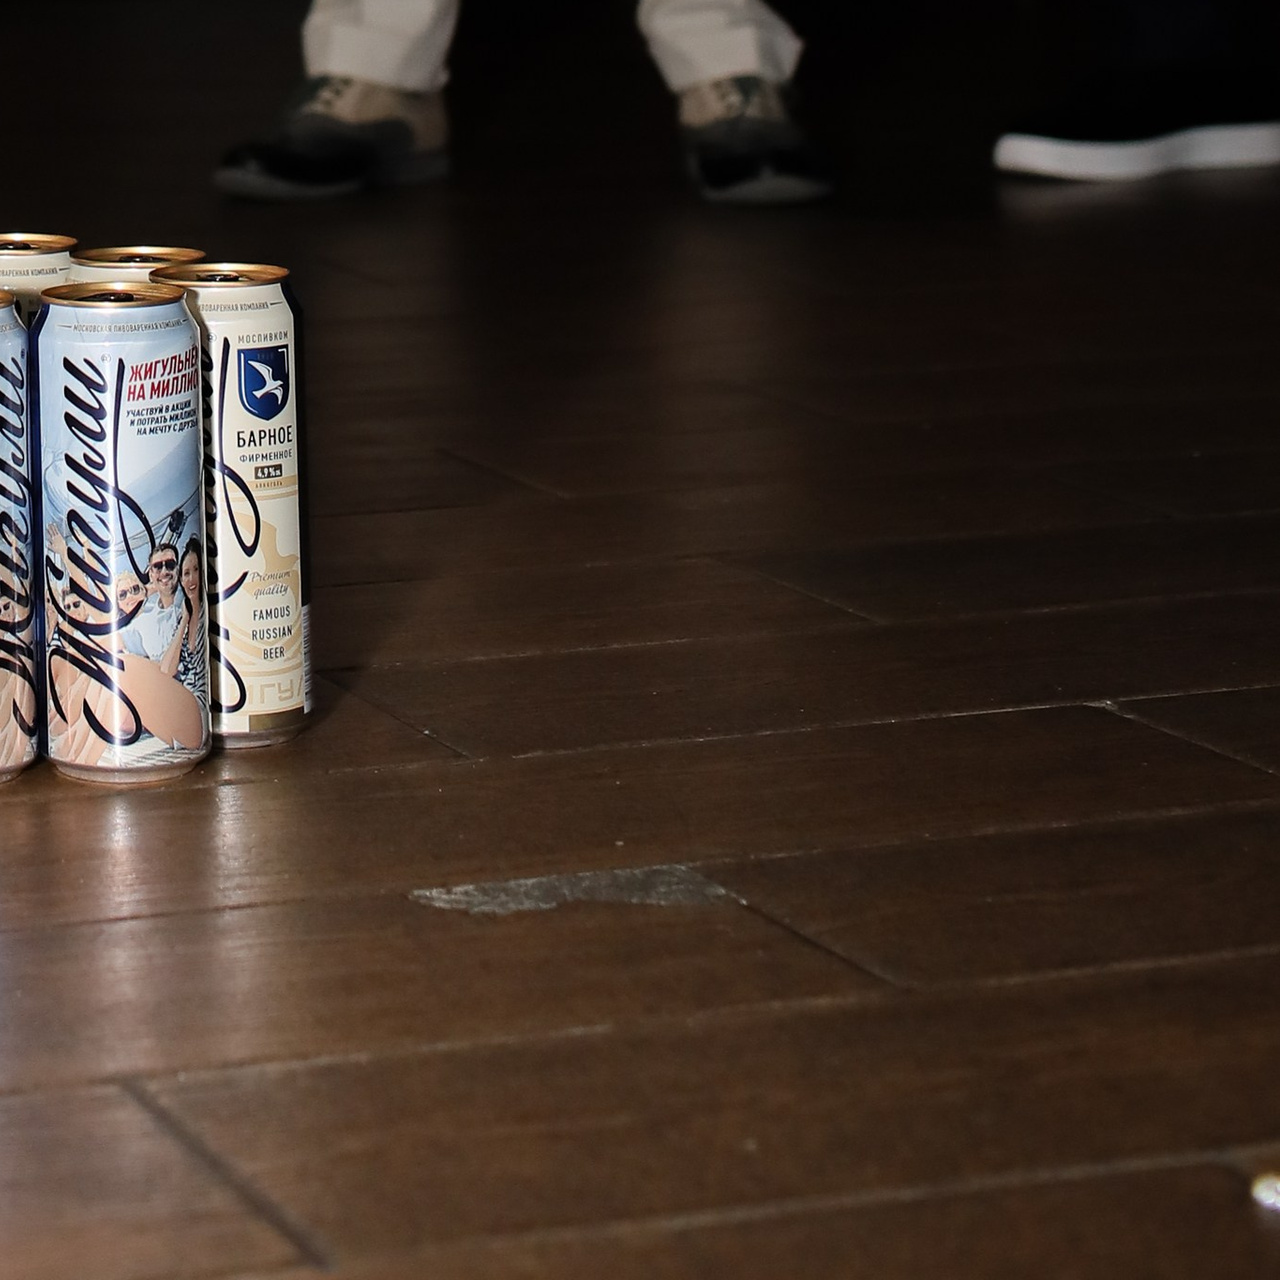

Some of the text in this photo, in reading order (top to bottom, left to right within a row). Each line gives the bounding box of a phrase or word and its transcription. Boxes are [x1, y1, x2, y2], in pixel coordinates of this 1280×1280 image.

[238, 332, 289, 344] МОСПИВКОМ
[129, 343, 198, 383] ЖИГУЛЬНЁ
[127, 367, 199, 402] НА МИЛЛИО
[126, 399, 192, 418] УЧАСТВУЙ В АКЦИИ
[129, 418, 135, 427] И
[136, 415, 168, 426] ПОТРАТЬ
[136, 427, 147, 436] НА
[148, 423, 172, 435] МЕЧТУ
[172, 423, 178, 432] С
[237, 425, 293, 448] БАРНОЕ
[239, 449, 293, 463] ФИРМЕННОЕ
[45, 356, 156, 746] Жигули
[250, 570, 292, 583] Premium
[253, 583, 290, 600] quality
[253, 605, 291, 622] FAMOUS
[251, 625, 293, 641] RUSSIAN
[263, 646, 286, 660] BEER
